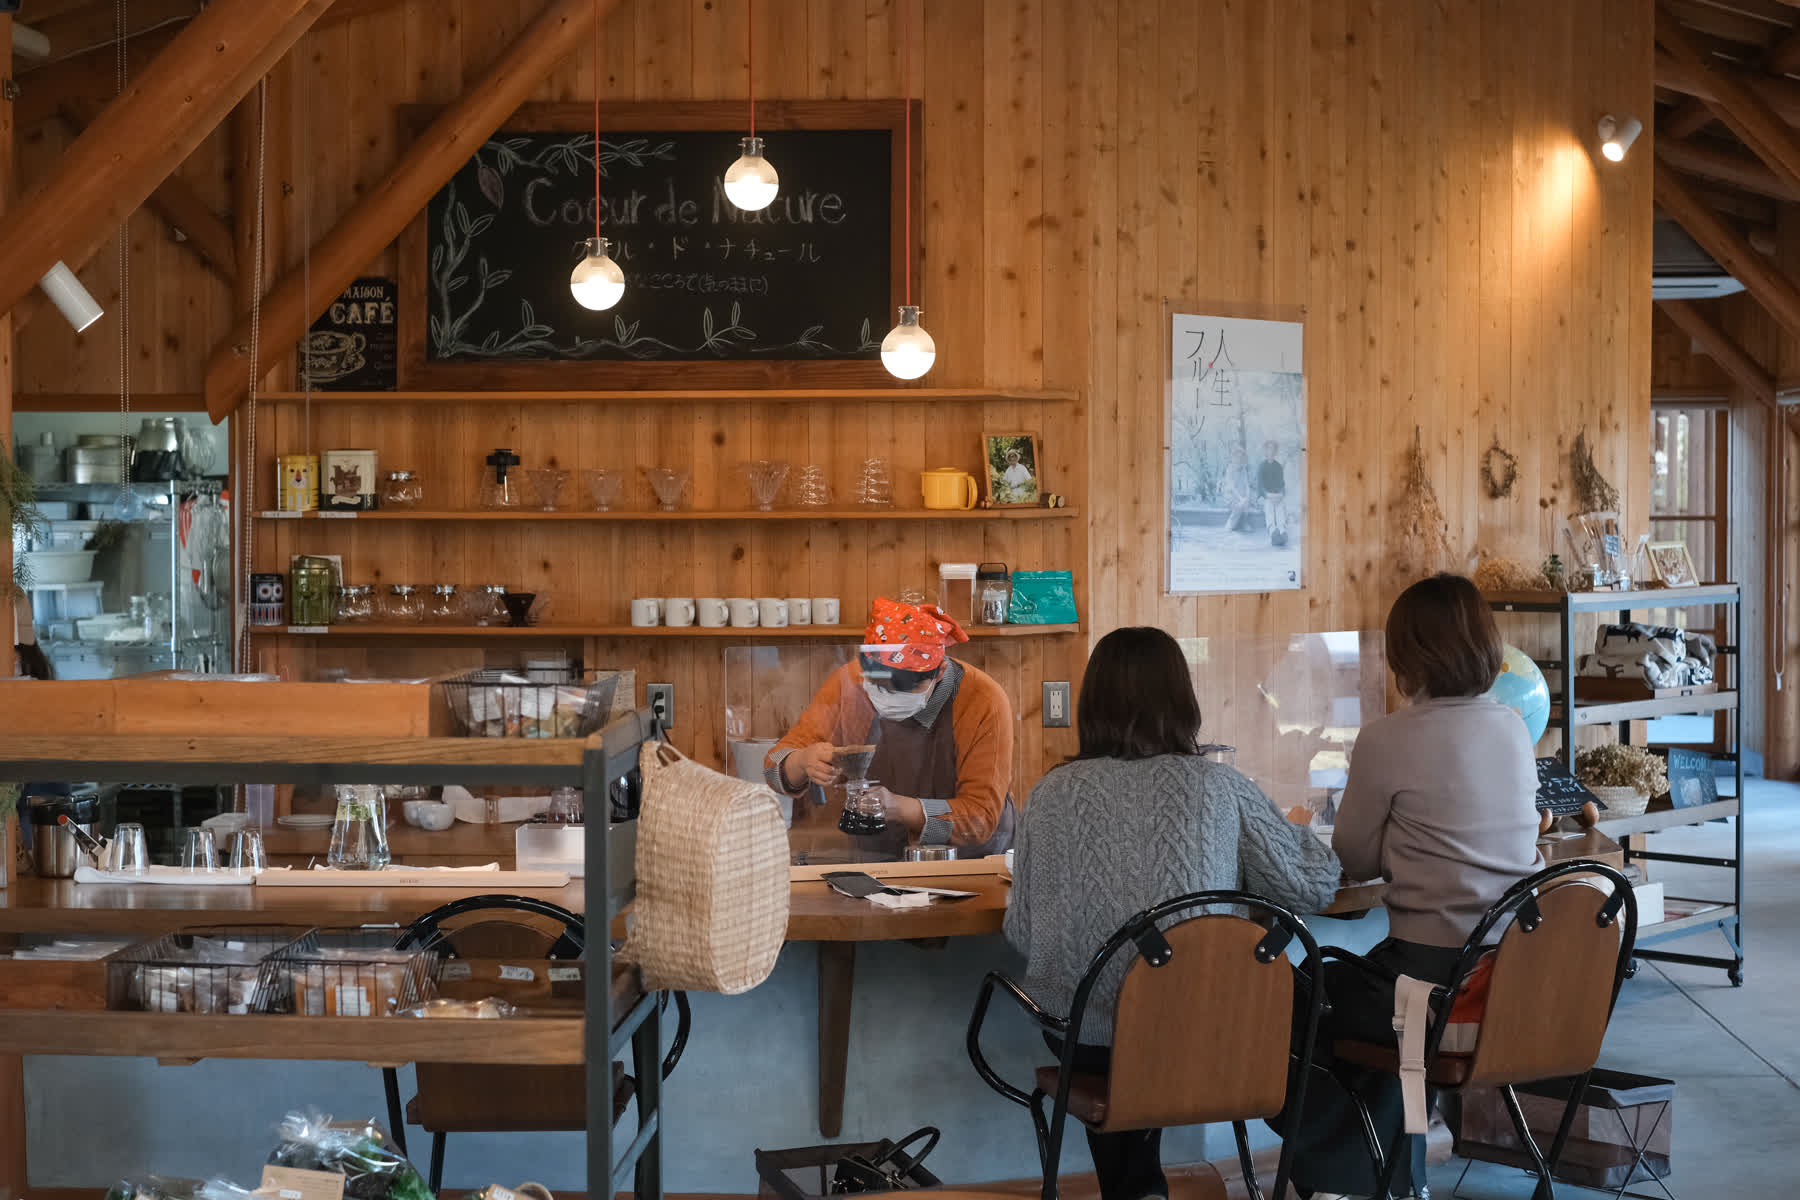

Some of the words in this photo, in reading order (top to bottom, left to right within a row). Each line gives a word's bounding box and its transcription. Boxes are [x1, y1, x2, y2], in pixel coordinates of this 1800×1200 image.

[654, 175, 699, 224] de
[329, 296, 394, 325] CAFÉ
[1184, 330, 1209, 440] フルーツ
[1208, 328, 1234, 408] 人生
[1673, 754, 1711, 771] WELCOM
